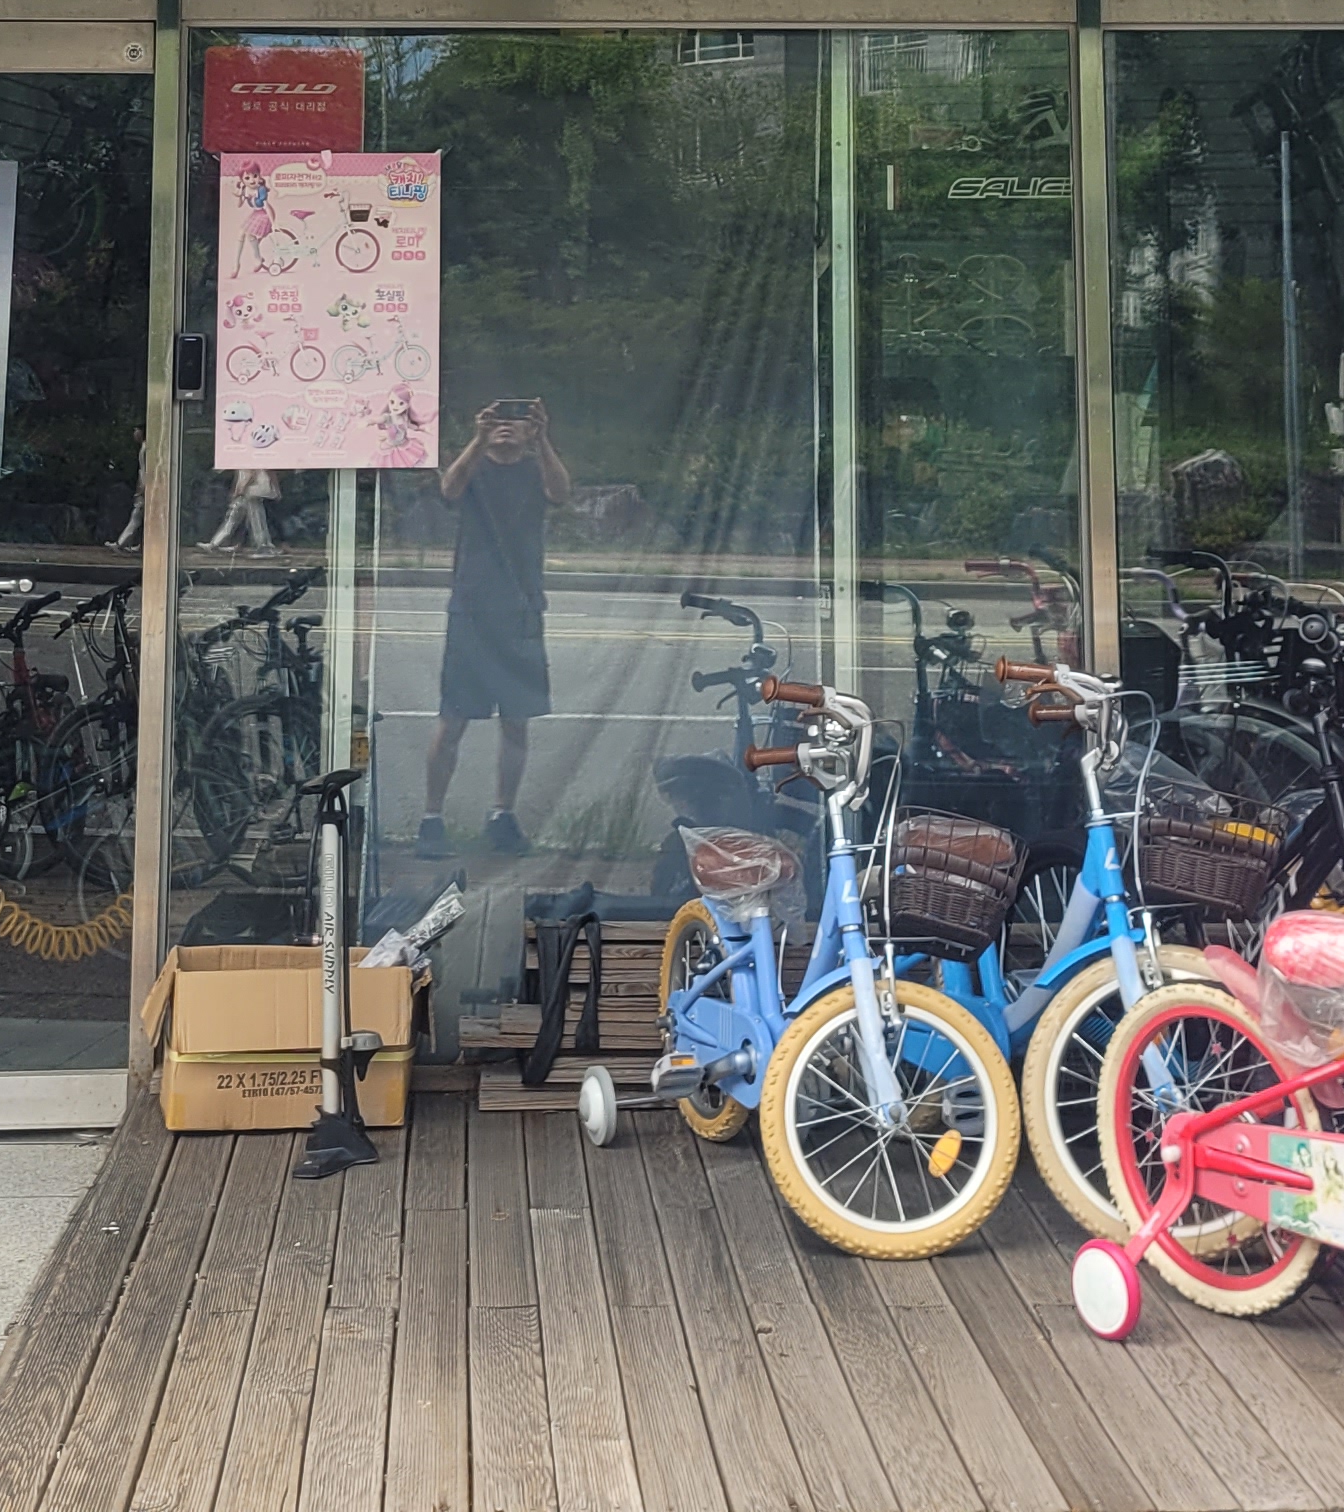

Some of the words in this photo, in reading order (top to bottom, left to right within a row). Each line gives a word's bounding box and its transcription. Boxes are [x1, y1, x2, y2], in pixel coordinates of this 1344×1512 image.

[230, 82, 338, 95] CELLO
[268, 101, 289, 112] 공식
[295, 101, 327, 112] 대리점
[389, 172, 424, 185] 캐치!
[948, 176, 1072, 199] SALIC
[388, 184, 428, 202] 티니핑
[323, 911, 335, 937] AIR
[324, 941, 335, 995] SUPPLY
[217, 1074, 233, 1090] 22
[236, 1072, 246, 1089] X
[249, 1070, 307, 1088] 1.75/2.25
[310, 1069, 324, 1085] F
